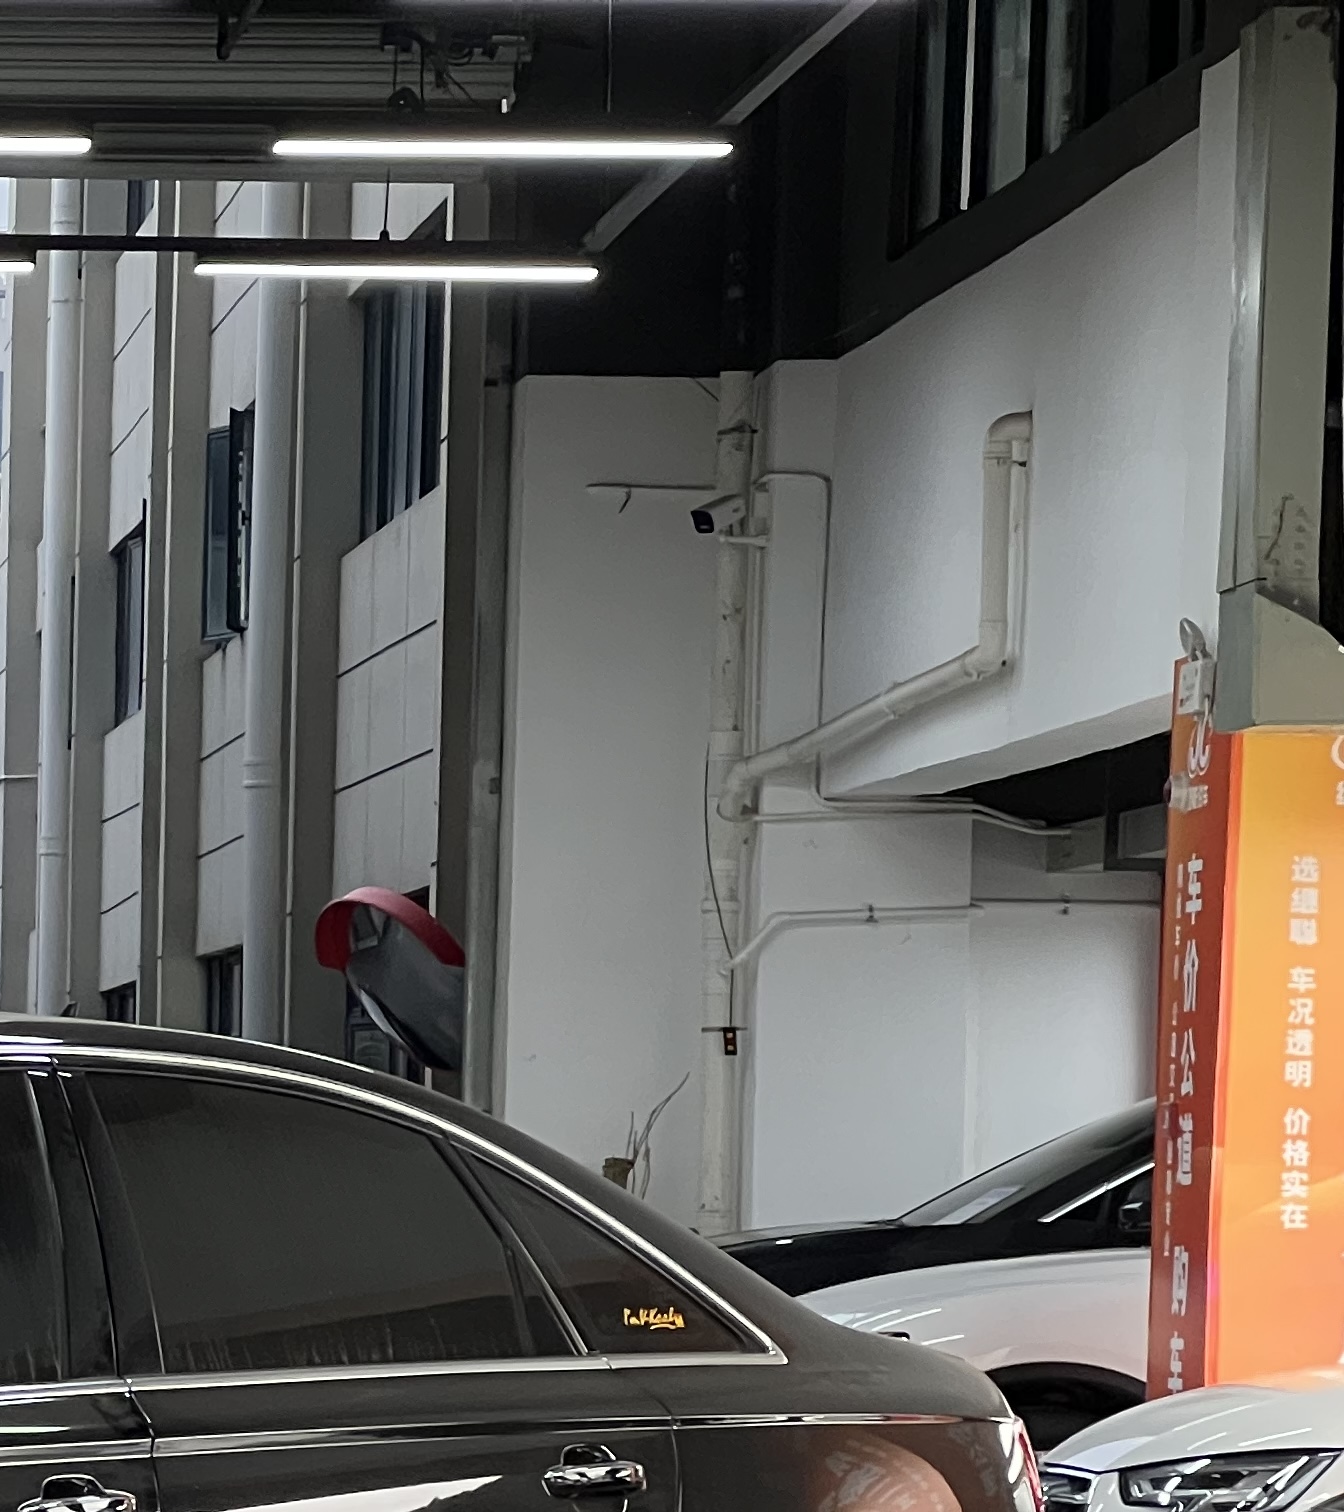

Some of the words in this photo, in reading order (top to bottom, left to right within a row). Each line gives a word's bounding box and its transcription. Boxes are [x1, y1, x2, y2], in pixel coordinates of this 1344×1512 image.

[1289, 856, 1319, 946] 选继聪
[1176, 852, 1199, 1186] 车价公道
[1285, 966, 1317, 1088] 车况透明
[1279, 1107, 1311, 1230] 价格实在
[1167, 1246, 1188, 1395] 购车
